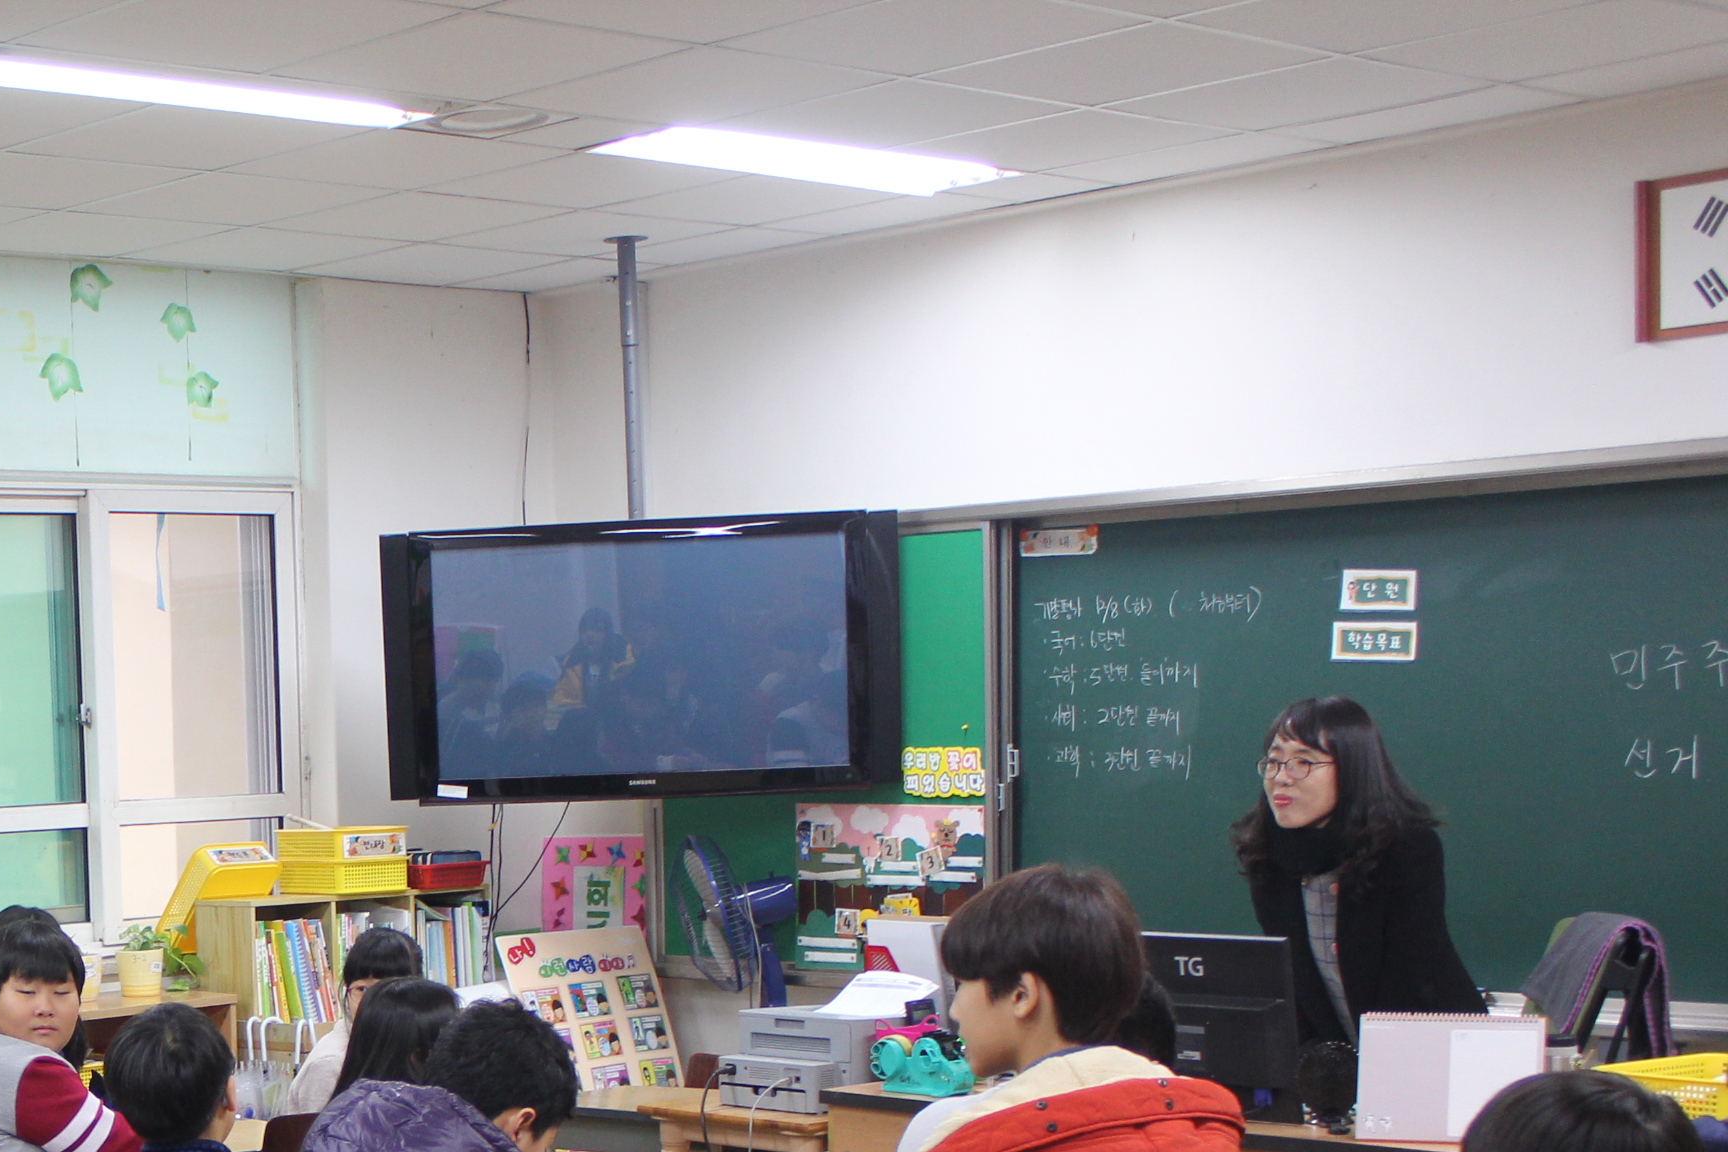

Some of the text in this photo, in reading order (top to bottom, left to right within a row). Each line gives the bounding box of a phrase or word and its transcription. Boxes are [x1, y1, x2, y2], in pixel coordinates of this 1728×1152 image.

[1363, 582, 1399, 599] 단원
[1347, 631, 1401, 651] 학습목표
[903, 751, 941, 771] 우리반
[1624, 735, 1697, 779] 선거
[905, 772, 984, 794] 피었습니다
[885, 844, 893, 857] 2
[927, 855, 935, 869] 3
[1174, 956, 1204, 976] TG
